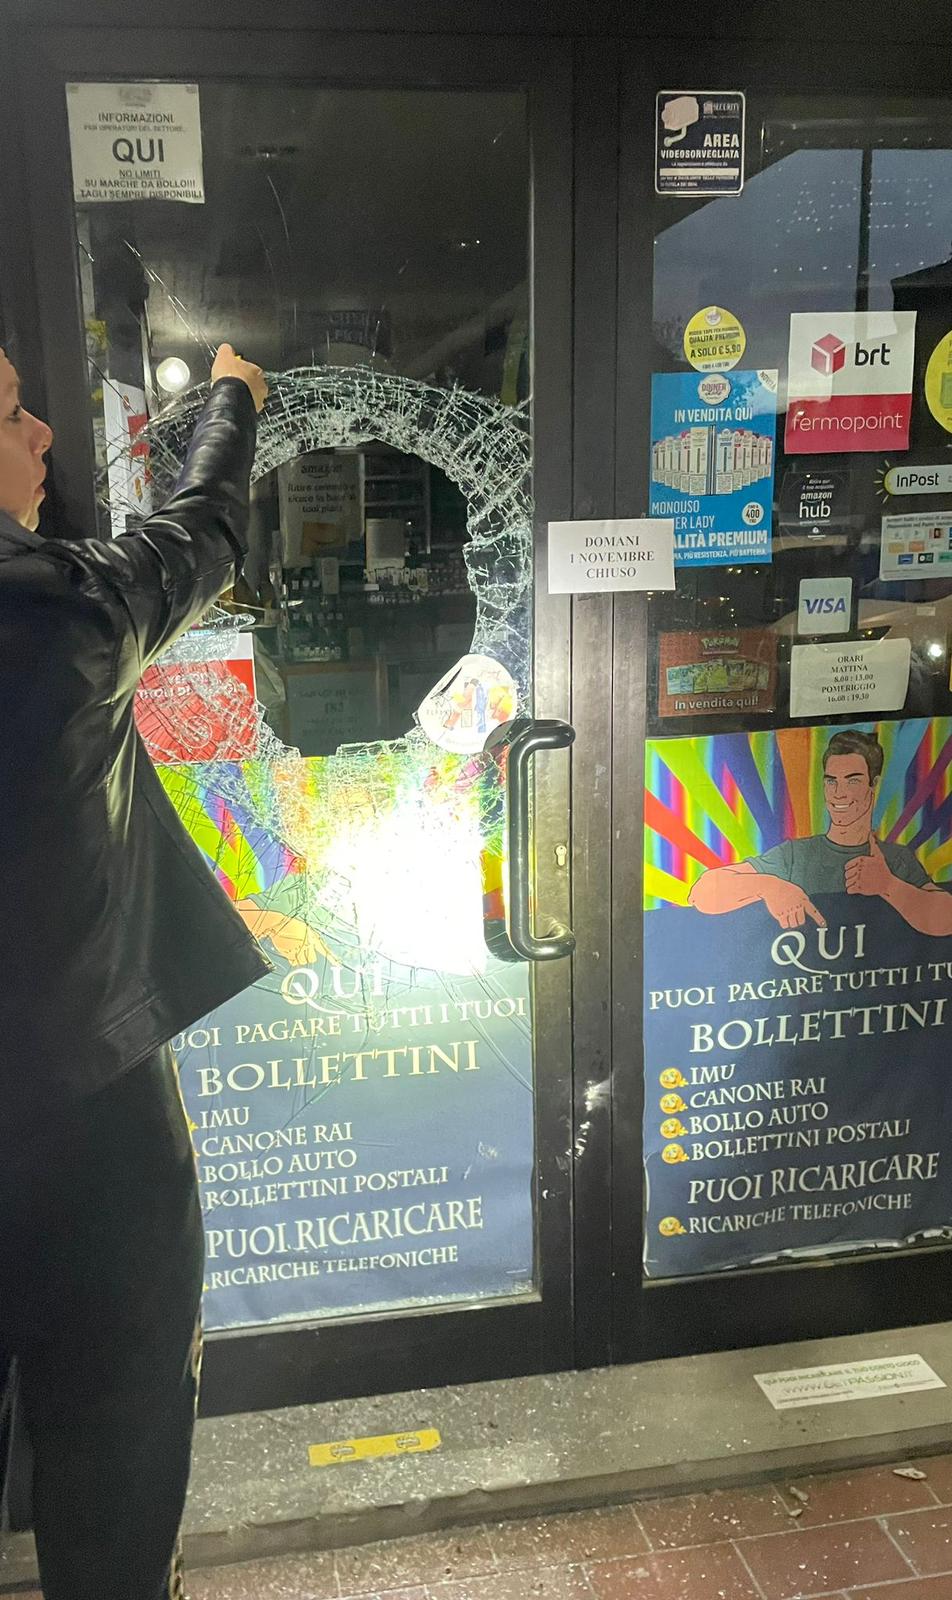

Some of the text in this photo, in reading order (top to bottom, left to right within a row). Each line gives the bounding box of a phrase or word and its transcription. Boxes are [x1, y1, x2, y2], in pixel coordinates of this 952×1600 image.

[703, 134, 740, 147] AREA
[112, 138, 165, 164] QUI
[660, 149, 740, 158] VIDEOSORVEGLIATA
[119, 170, 132, 178] NO
[85, 180, 97, 188] SU
[100, 180, 138, 188] MARCHE
[141, 180, 154, 188] DA
[80, 189, 107, 198] TAGLI
[110, 190, 147, 198] SEMPRE
[690, 349, 696, 358] A
[697, 347, 716, 357] SOLO
[855, 342, 890, 366] brt
[675, 407, 753, 423] IN VENDITA QUI
[792, 411, 903, 433] fermopoint
[896, 472, 940, 488] InPost
[800, 491, 832, 500] amazon
[651, 500, 700, 515] MONOUSO
[745, 509, 760, 518] 400
[800, 501, 831, 518] hub
[690, 515, 715, 529] LADY
[585, 535, 640, 547] DOMANI
[709, 530, 768, 547] PREMIUM
[579, 551, 655, 563] NOVEMBRE
[586, 567, 637, 578] CHIUSO
[803, 598, 846, 614] VISA
[837, 654, 863, 663] ORARI
[831, 665, 868, 673] MATTINA
[821, 683, 876, 693] POMERIGGIO
[675, 696, 759, 710] In vendita qui!
[771, 924, 866, 974] QUI
[281, 963, 385, 1015] QUI
[649, 986, 716, 1010] PUOI
[728, 975, 823, 1003] PAGARE
[829, 967, 909, 992] TUTTI
[915, 965, 923, 982] I
[170, 997, 527, 1051] UOI PAGARE TUTTI I TUOI
[689, 998, 948, 1053] BOLLETTINI
[196, 1040, 481, 1097] BOLLETTINI
[690, 1064, 736, 1085] IMU
[690, 1077, 826, 1108] CANONE RAI
[200, 1107, 250, 1129] IMU
[689, 1101, 829, 1135] BOLLO AUTO
[202, 1122, 353, 1157] CANONE RAI
[691, 1119, 911, 1161] BOLLETTINI POSTALI
[203, 1149, 357, 1184] BOLLO AUTO
[354, 1166, 448, 1192] POSTALI
[687, 1152, 940, 1204] PUOI RICARICARE
[689, 1193, 912, 1234] RICARICHE TELEFONICHE
[206, 1196, 484, 1258] PUOI RICARICARE
[211, 1245, 458, 1290] RICARICHE TELEFONICHE
